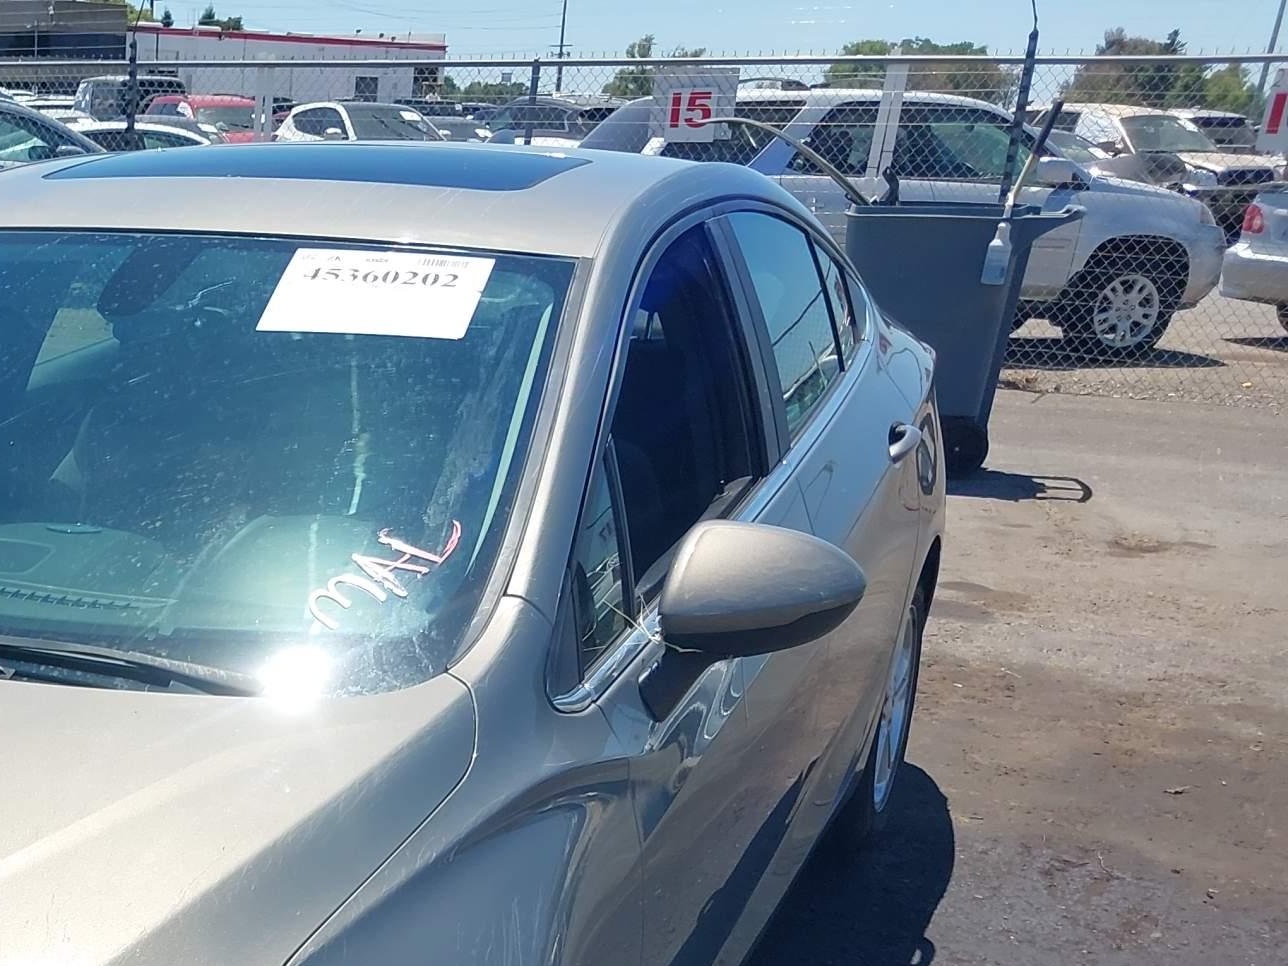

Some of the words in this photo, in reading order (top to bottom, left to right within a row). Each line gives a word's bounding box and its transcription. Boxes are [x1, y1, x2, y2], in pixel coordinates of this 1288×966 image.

[669, 91, 713, 129] 15
[1265, 93, 1288, 134] 1
[303, 266, 460, 288] 45360202
